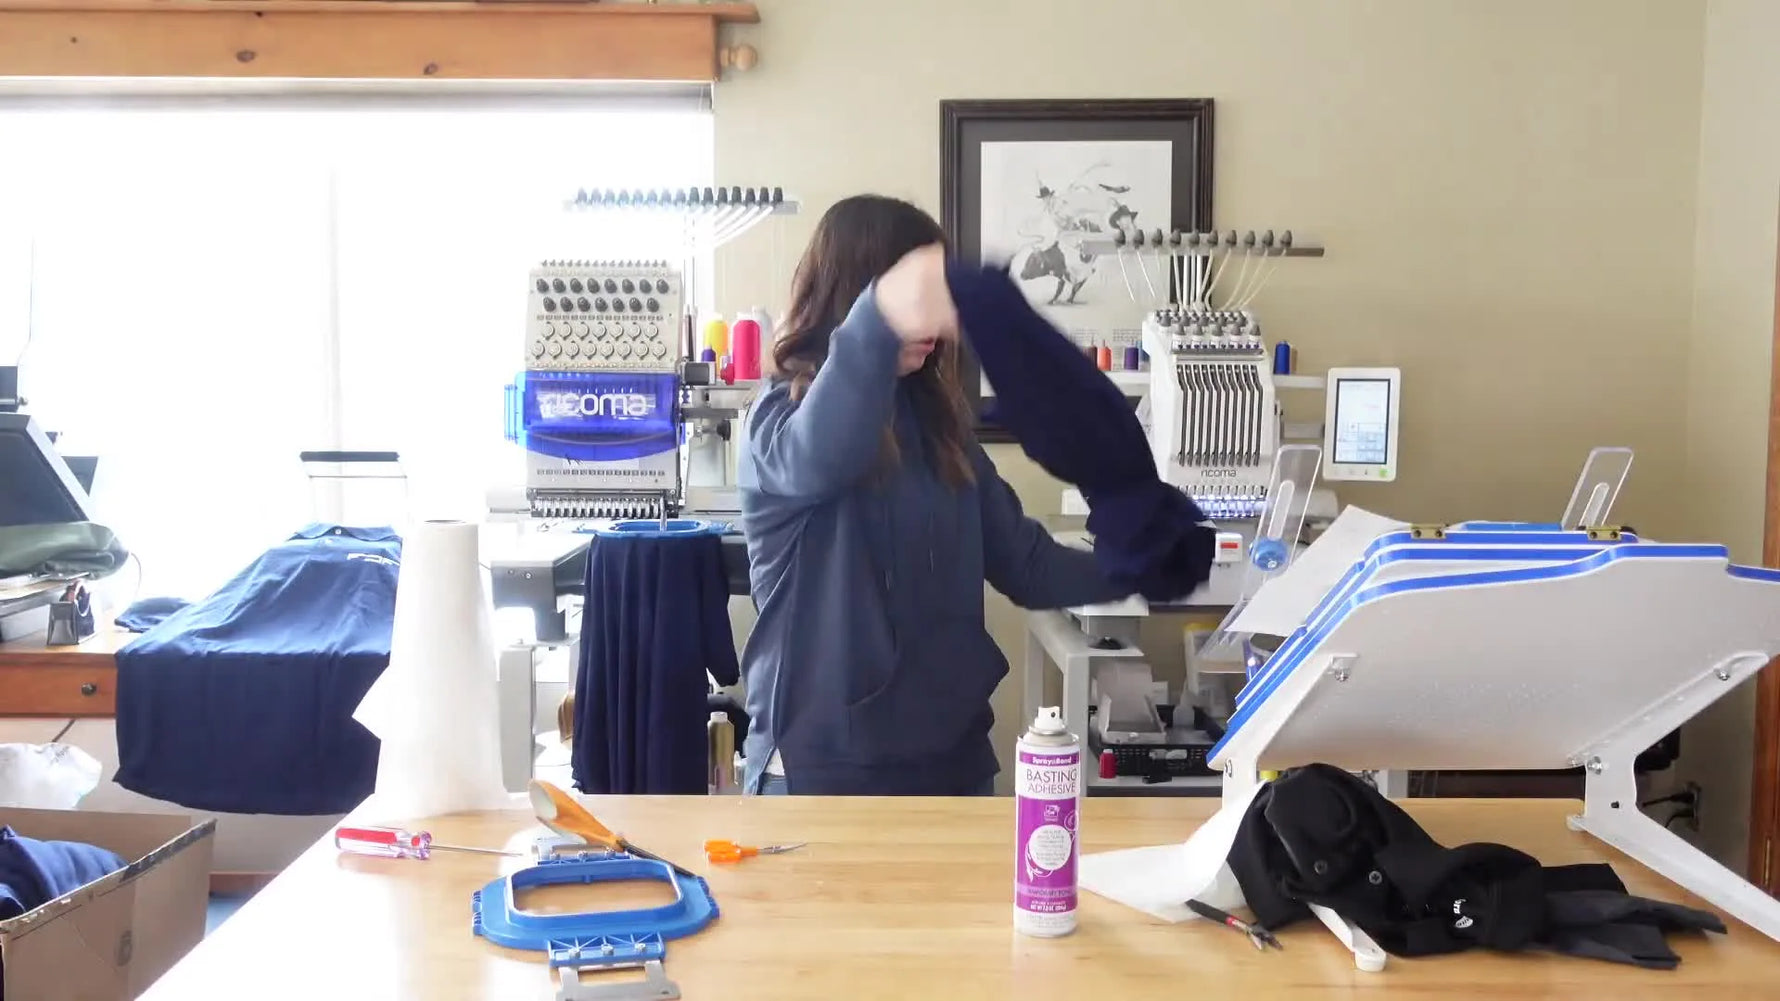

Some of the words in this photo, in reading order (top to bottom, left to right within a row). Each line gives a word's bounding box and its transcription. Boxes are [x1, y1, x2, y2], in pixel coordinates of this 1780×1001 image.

[1201, 469, 1237, 478] ricoma
[1026, 768, 1077, 783] BASTING
[1027, 782, 1076, 794] ADHESIVE
